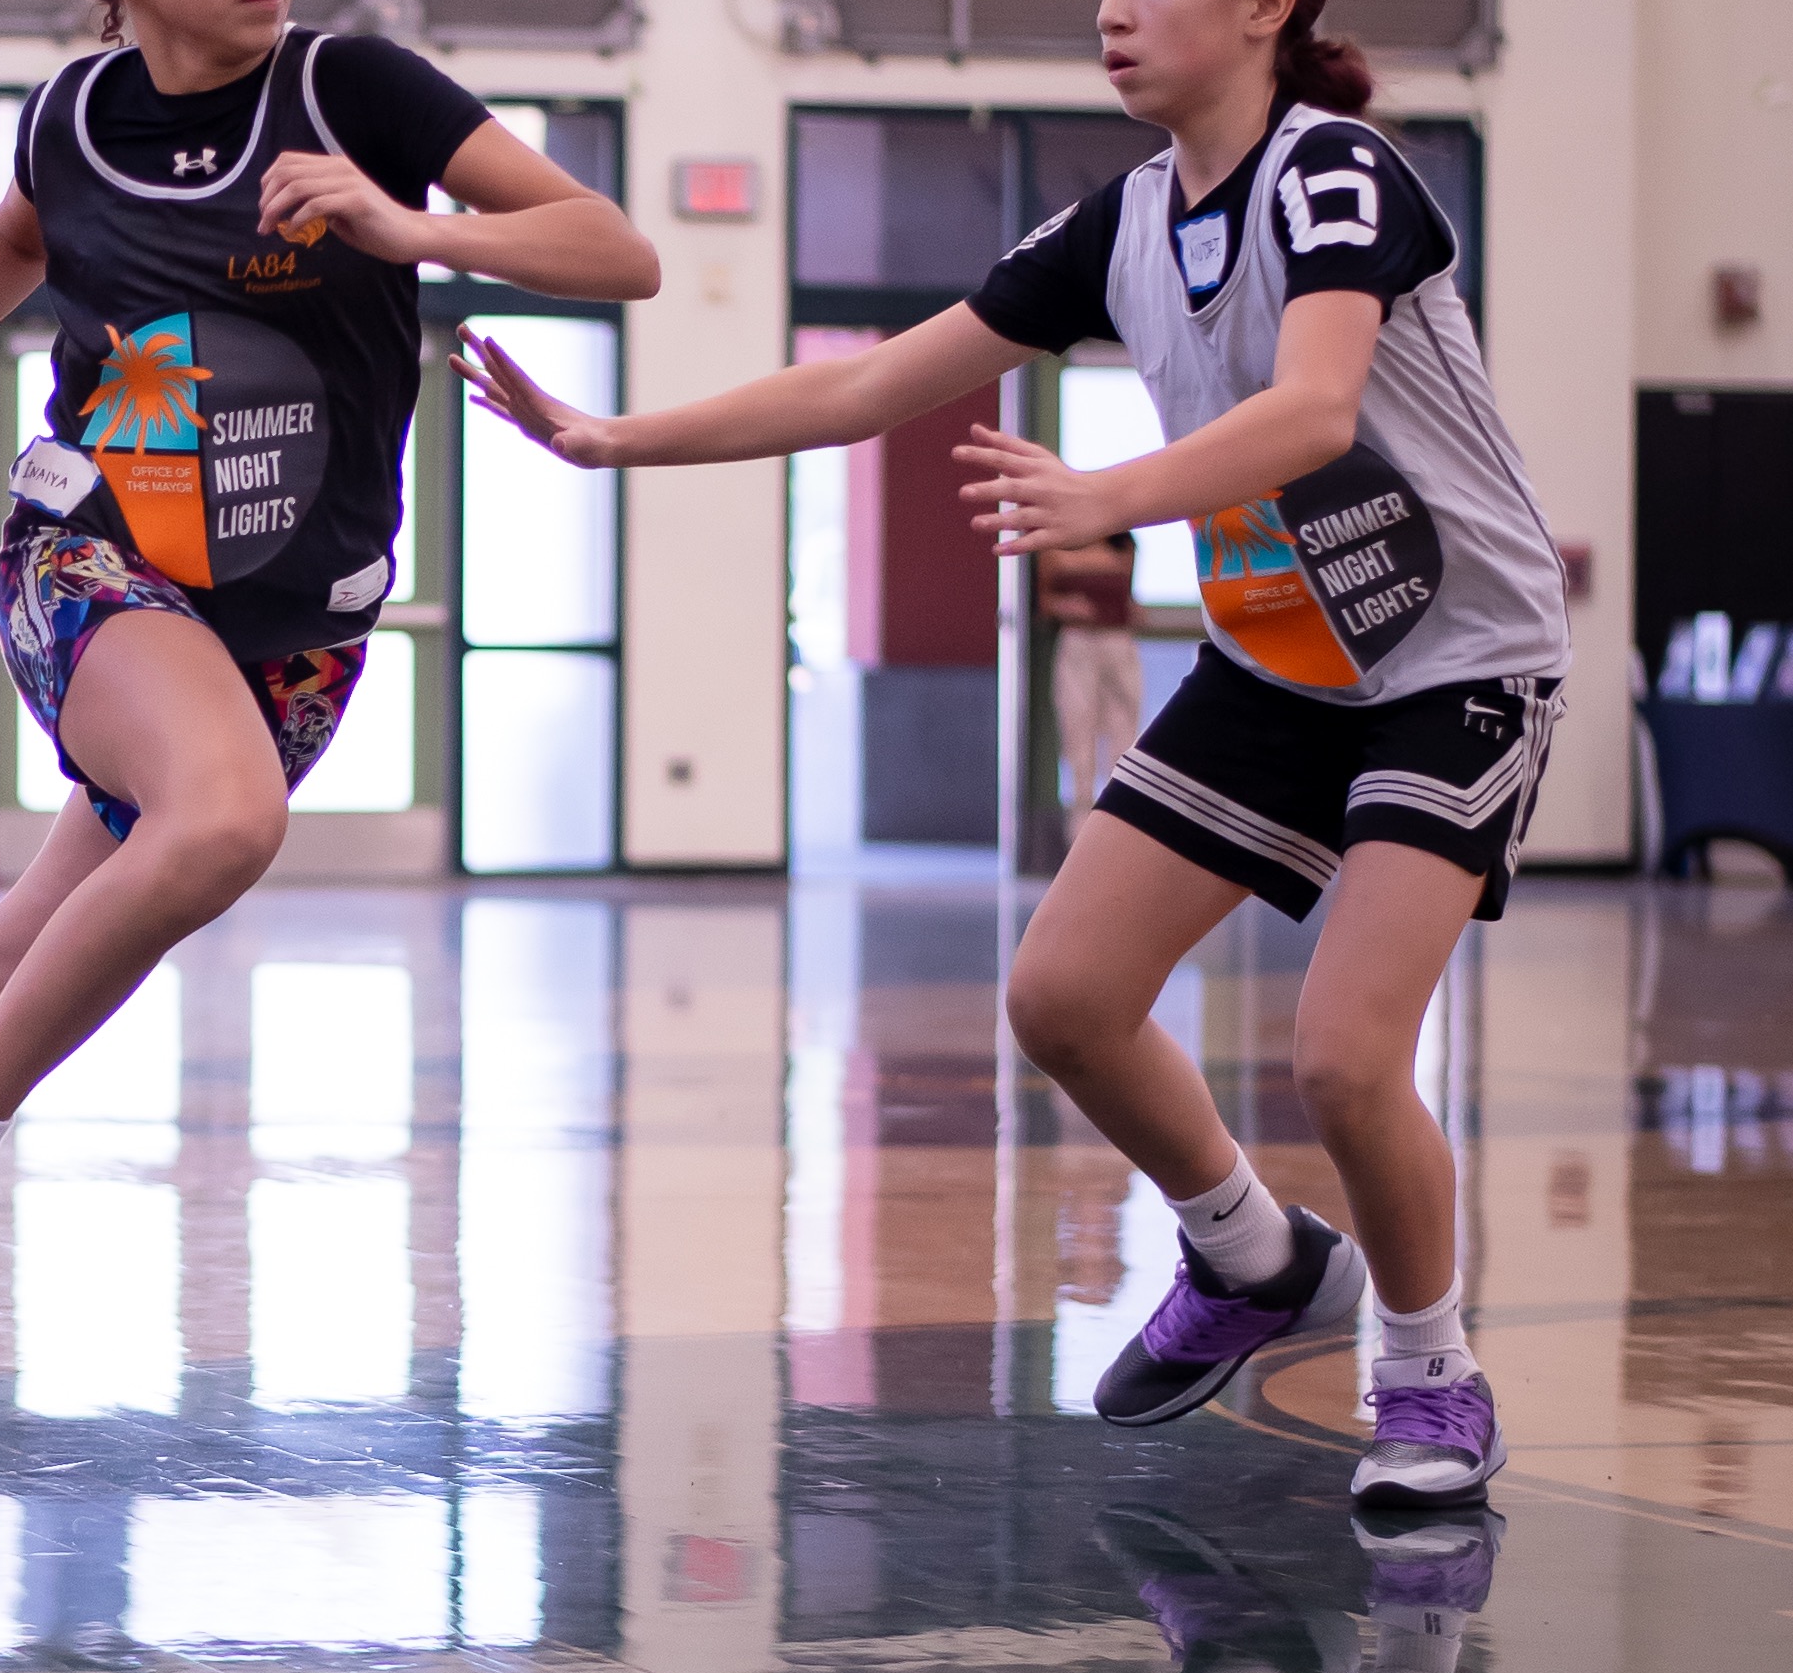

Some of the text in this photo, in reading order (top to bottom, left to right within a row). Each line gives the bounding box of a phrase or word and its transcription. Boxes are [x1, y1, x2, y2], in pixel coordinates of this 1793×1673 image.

[227, 250, 297, 280] LA84
[212, 402, 315, 446] SUMMER
[126, 480, 193, 493] THE MAYOR
[131, 466, 192, 478] OFFICE OF
[214, 449, 282, 495] NIGHT
[217, 496, 296, 540] LIGHTS
[1299, 491, 1411, 556] SUMMER
[1317, 539, 1396, 598] NIGHT
[1341, 576, 1431, 636] LIGHTS
[1464, 712, 1503, 740] FLY
